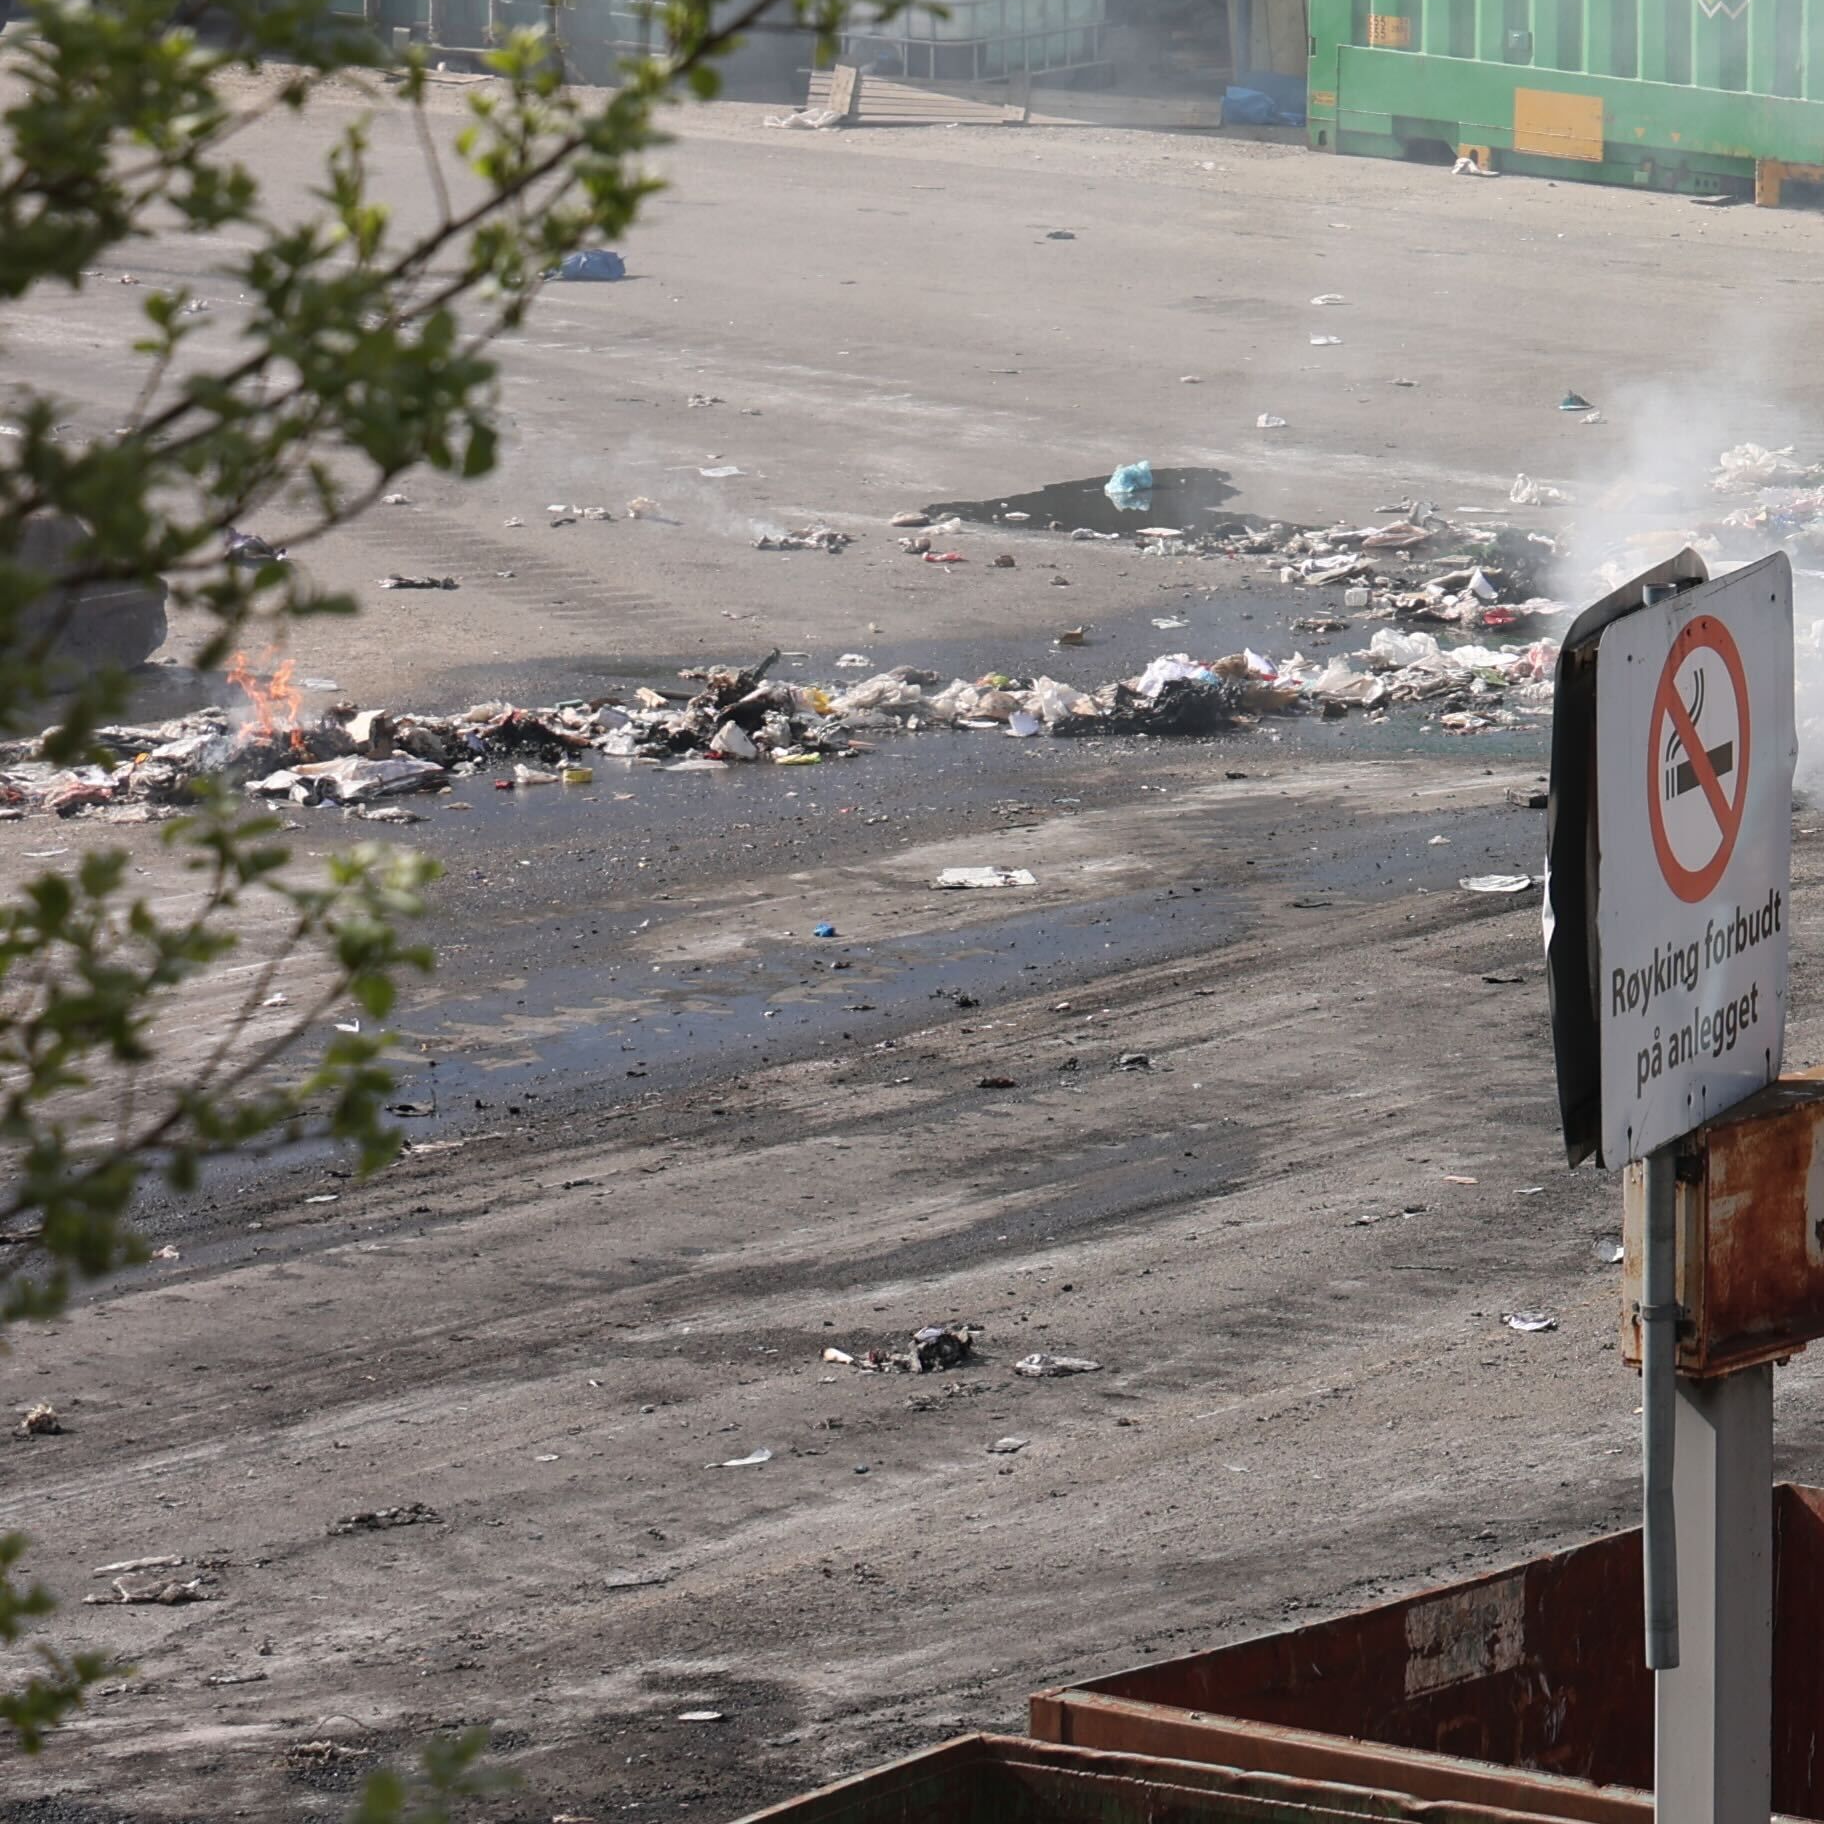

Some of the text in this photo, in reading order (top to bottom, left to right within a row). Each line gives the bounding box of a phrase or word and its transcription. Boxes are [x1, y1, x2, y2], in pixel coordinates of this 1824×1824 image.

[1611, 887, 1782, 1019] Røyking forbudt
[1636, 982, 1759, 1101] på anlegget
